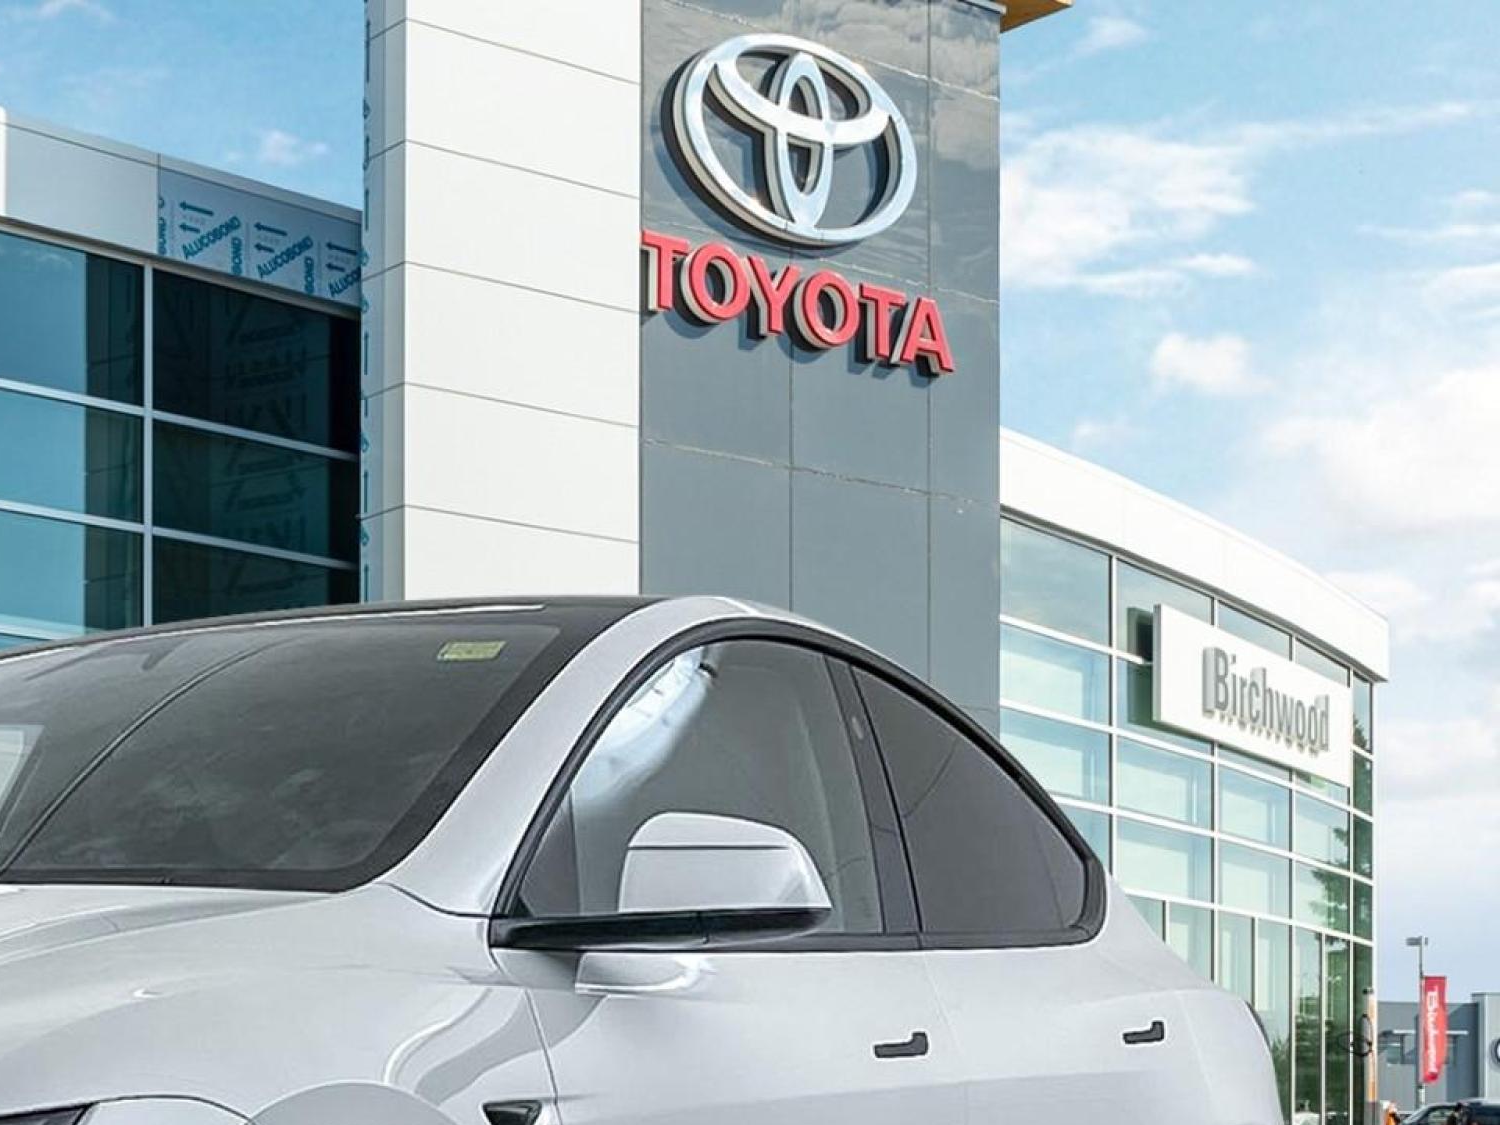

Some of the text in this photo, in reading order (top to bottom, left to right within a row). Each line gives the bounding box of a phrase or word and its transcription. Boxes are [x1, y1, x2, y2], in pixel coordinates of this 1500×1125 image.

[182, 216, 241, 260] ALUCOBOND
[257, 236, 313, 278] ALUCOBOND
[641, 229, 955, 373] TOYOTA
[1205, 647, 1329, 753] Birchwood
